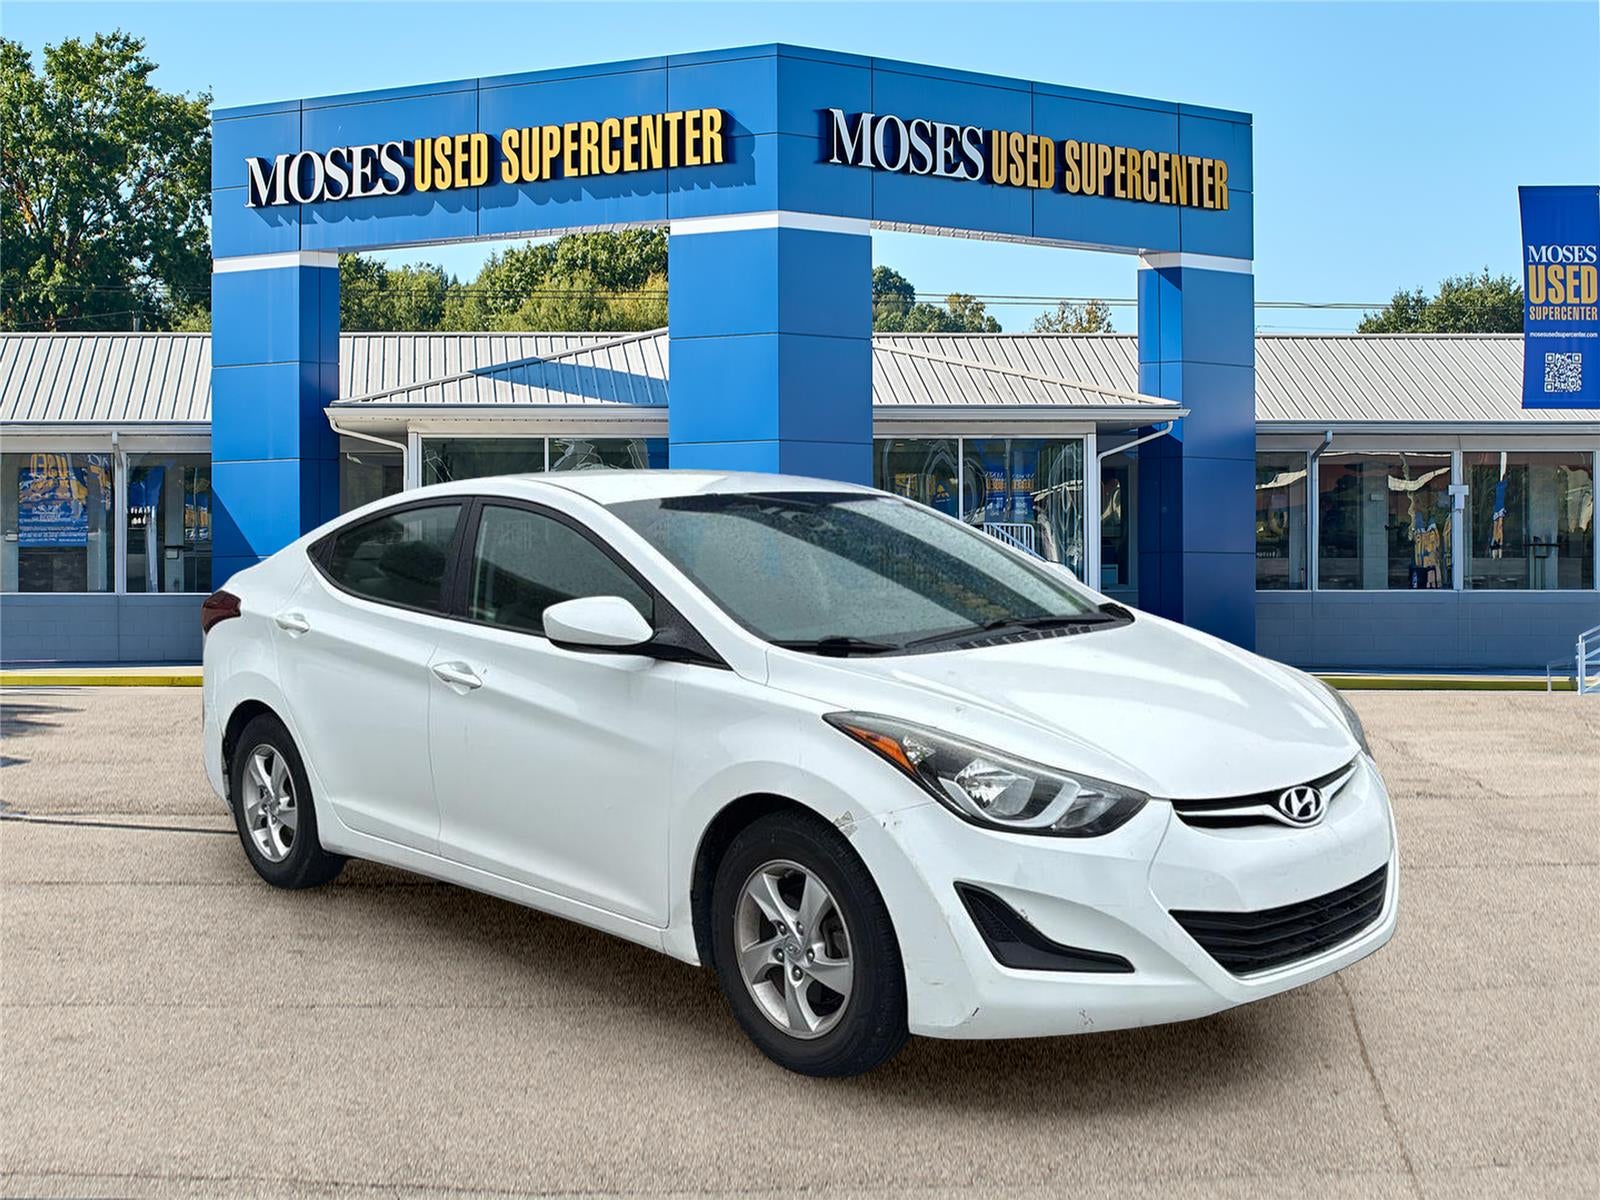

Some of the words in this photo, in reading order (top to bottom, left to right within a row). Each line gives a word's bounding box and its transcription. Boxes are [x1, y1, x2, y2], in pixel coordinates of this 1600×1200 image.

[244, 141, 407, 208] MOSES
[413, 132, 489, 193] USED
[501, 107, 725, 185] SUPERCENTER
[829, 108, 985, 182] MOSES
[990, 129, 1056, 190] USED
[1064, 139, 1230, 211] SUPERCENTER
[1527, 245, 1598, 263] MOSES
[1528, 264, 1599, 305] USED
[1529, 306, 1599, 321] SUPERCENTER
